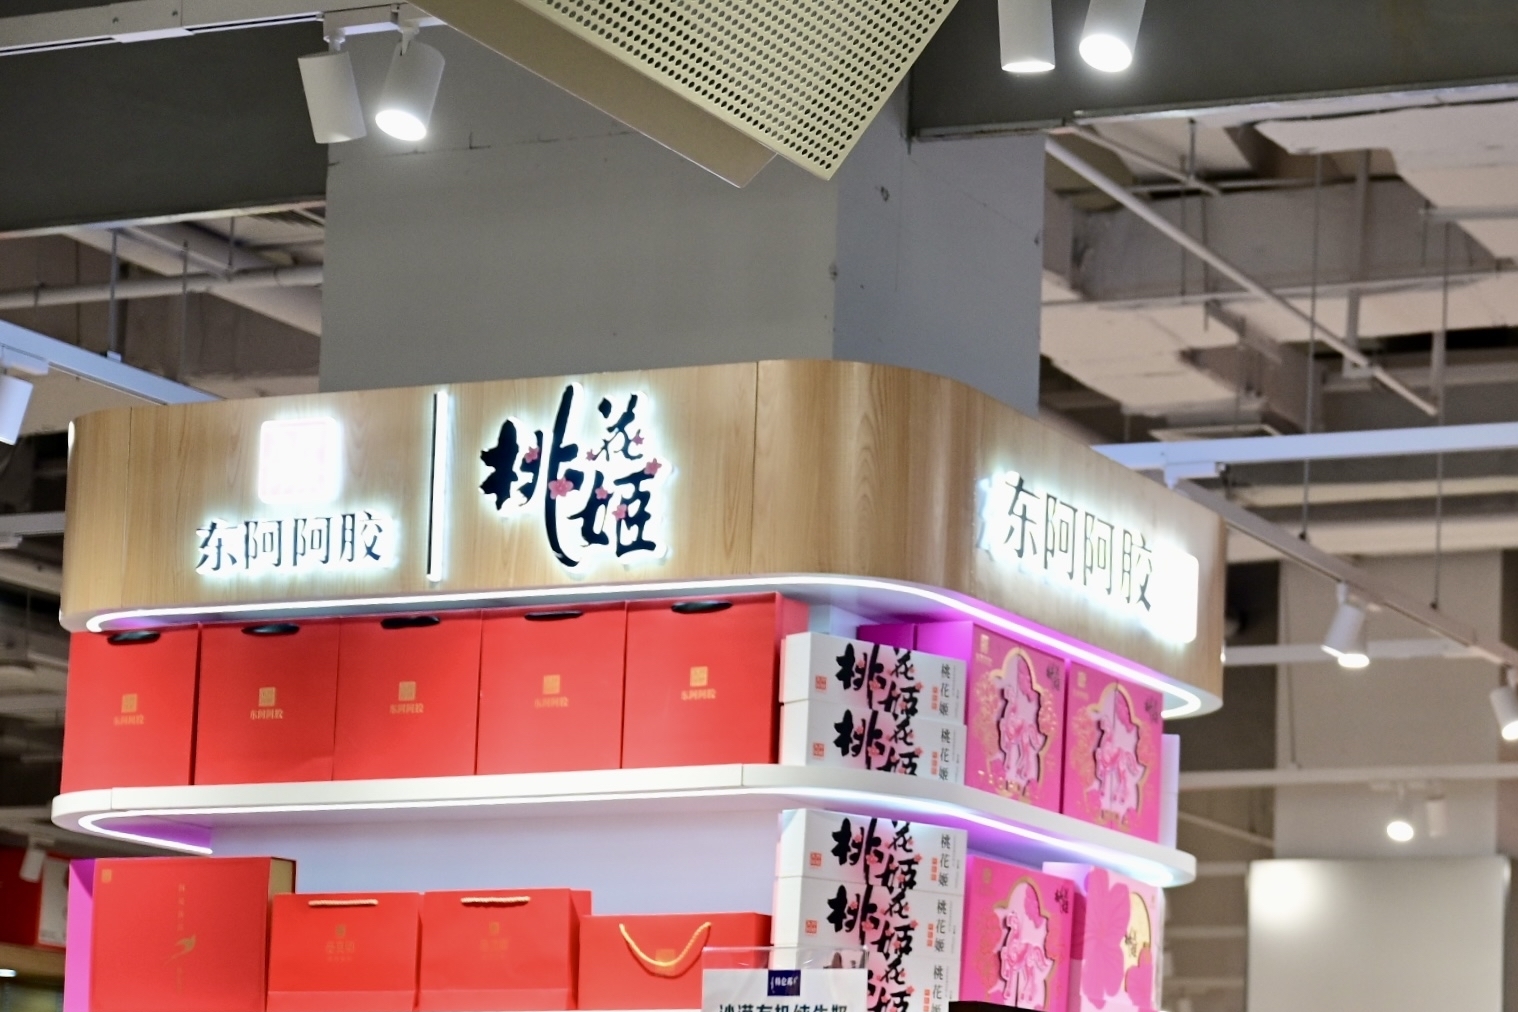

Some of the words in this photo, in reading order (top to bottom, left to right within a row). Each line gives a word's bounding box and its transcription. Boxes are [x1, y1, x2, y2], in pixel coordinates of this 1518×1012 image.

[195, 510, 383, 571] 东阿阿胶
[480, 384, 664, 568] 桃花姬
[1004, 475, 1153, 611] 东阿阿胶
